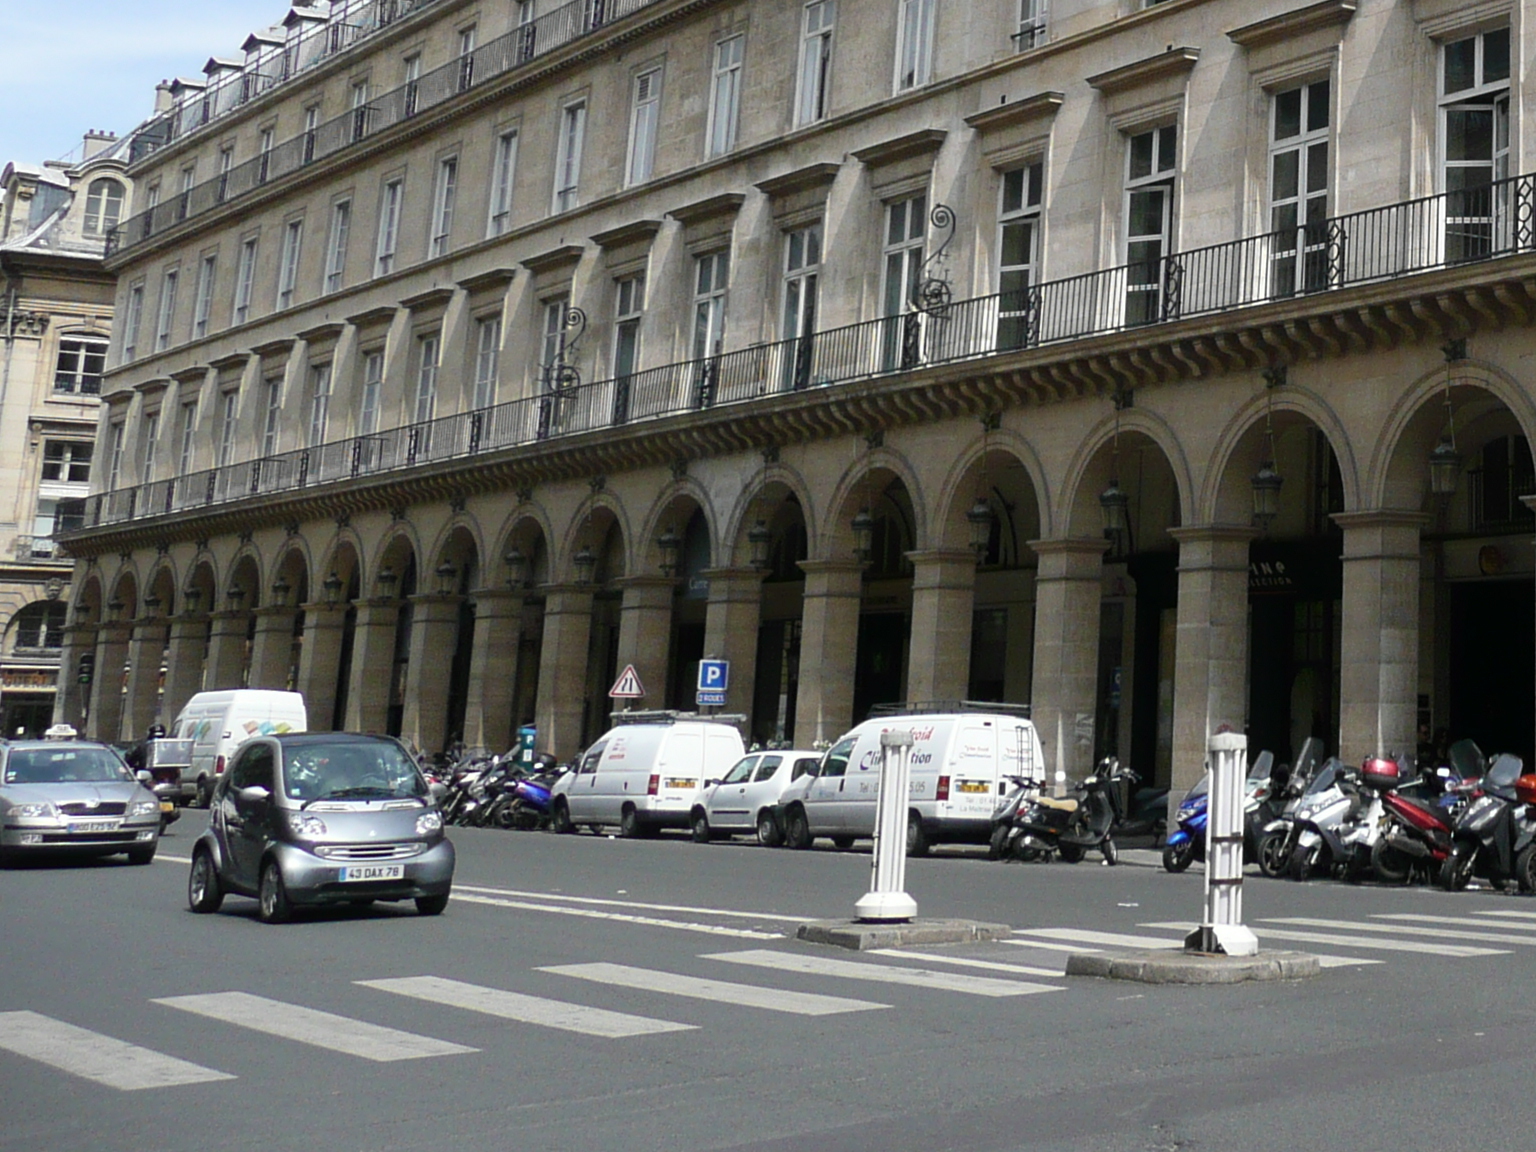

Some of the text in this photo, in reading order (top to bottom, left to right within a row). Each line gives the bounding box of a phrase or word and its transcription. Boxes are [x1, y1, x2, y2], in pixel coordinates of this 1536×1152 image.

[706, 666, 721, 685] P
[349, 866, 399, 879] 43 DAX 78
